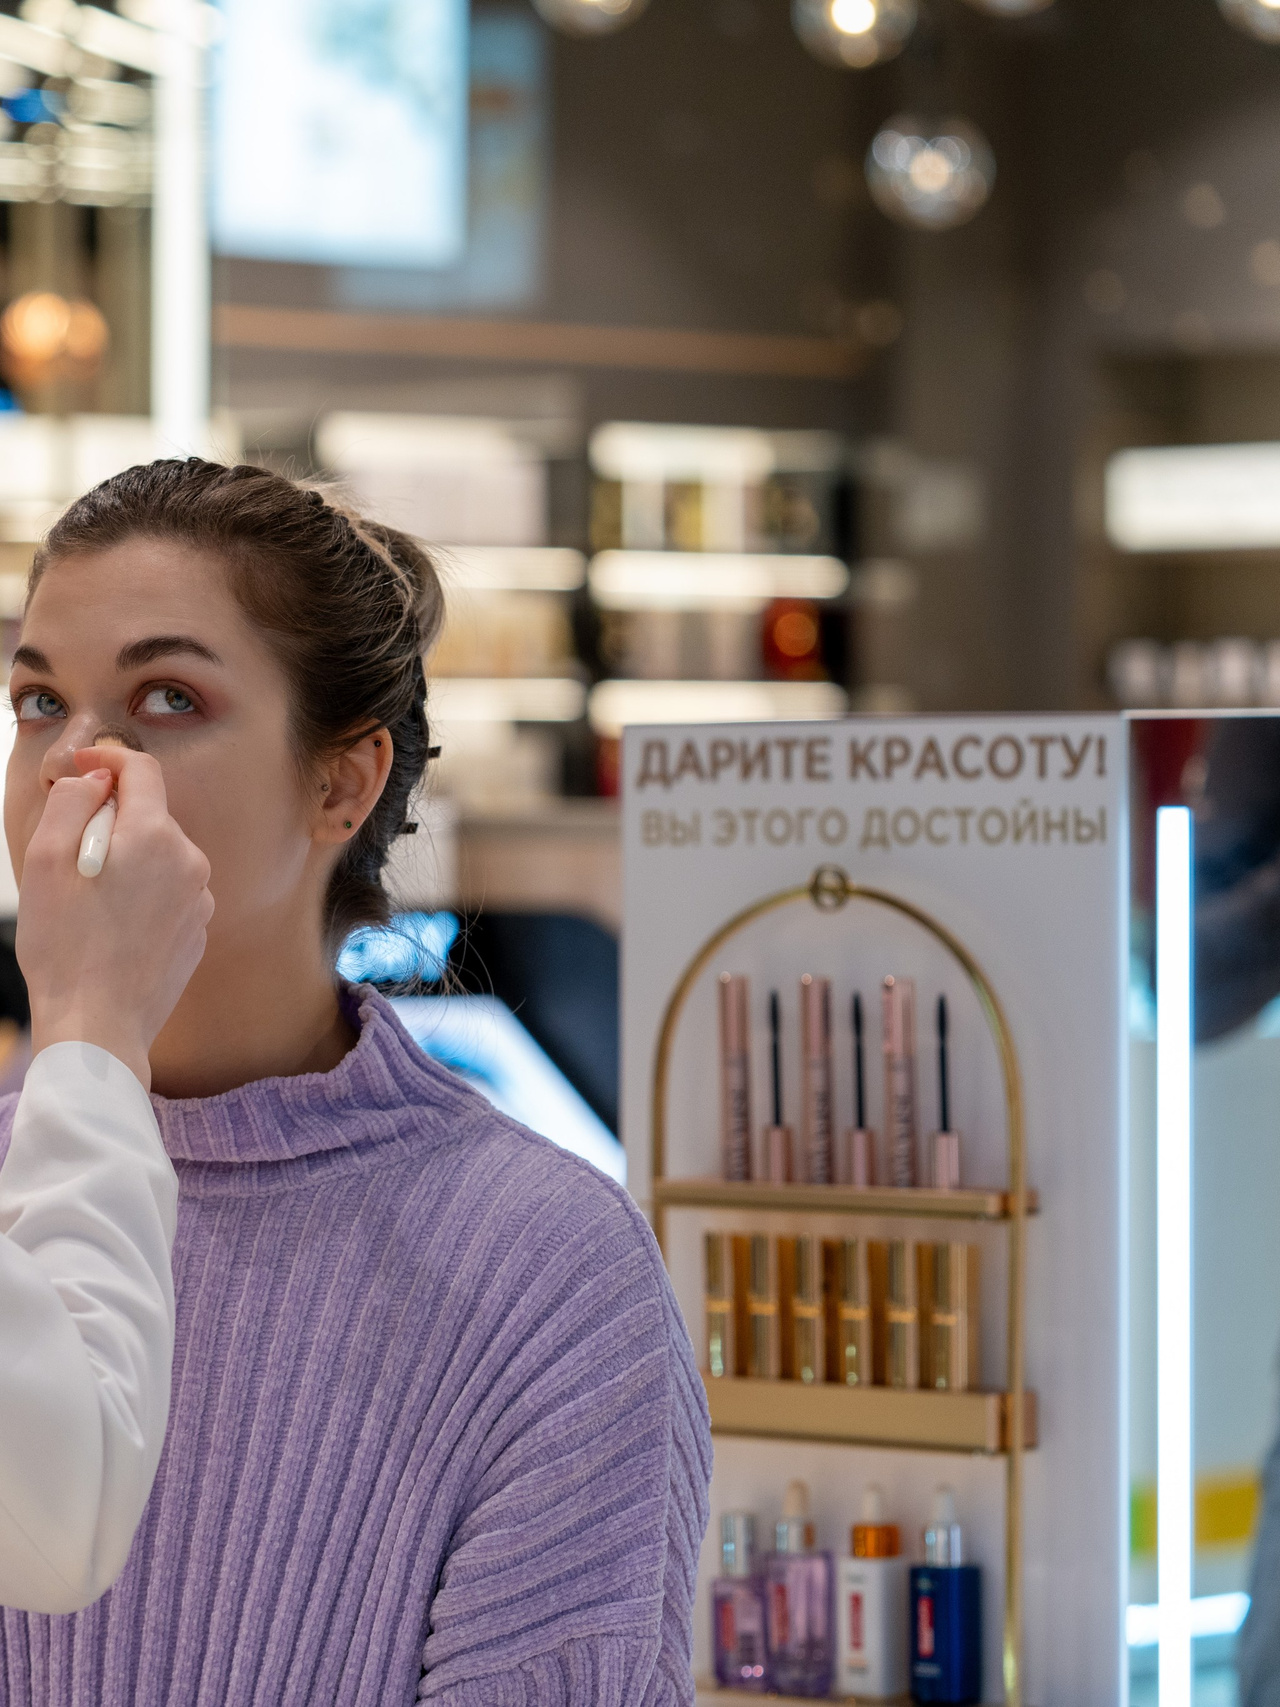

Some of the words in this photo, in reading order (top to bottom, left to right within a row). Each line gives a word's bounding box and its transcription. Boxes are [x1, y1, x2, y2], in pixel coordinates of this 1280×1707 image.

[637, 737, 832, 790] ДАРИТЕ
[849, 735, 1108, 781] КРАСОТУ!
[640, 808, 702, 847] ВЫ
[713, 807, 849, 847] ЭТОГО
[860, 800, 1107, 849] ДОСТОЙНЫ
